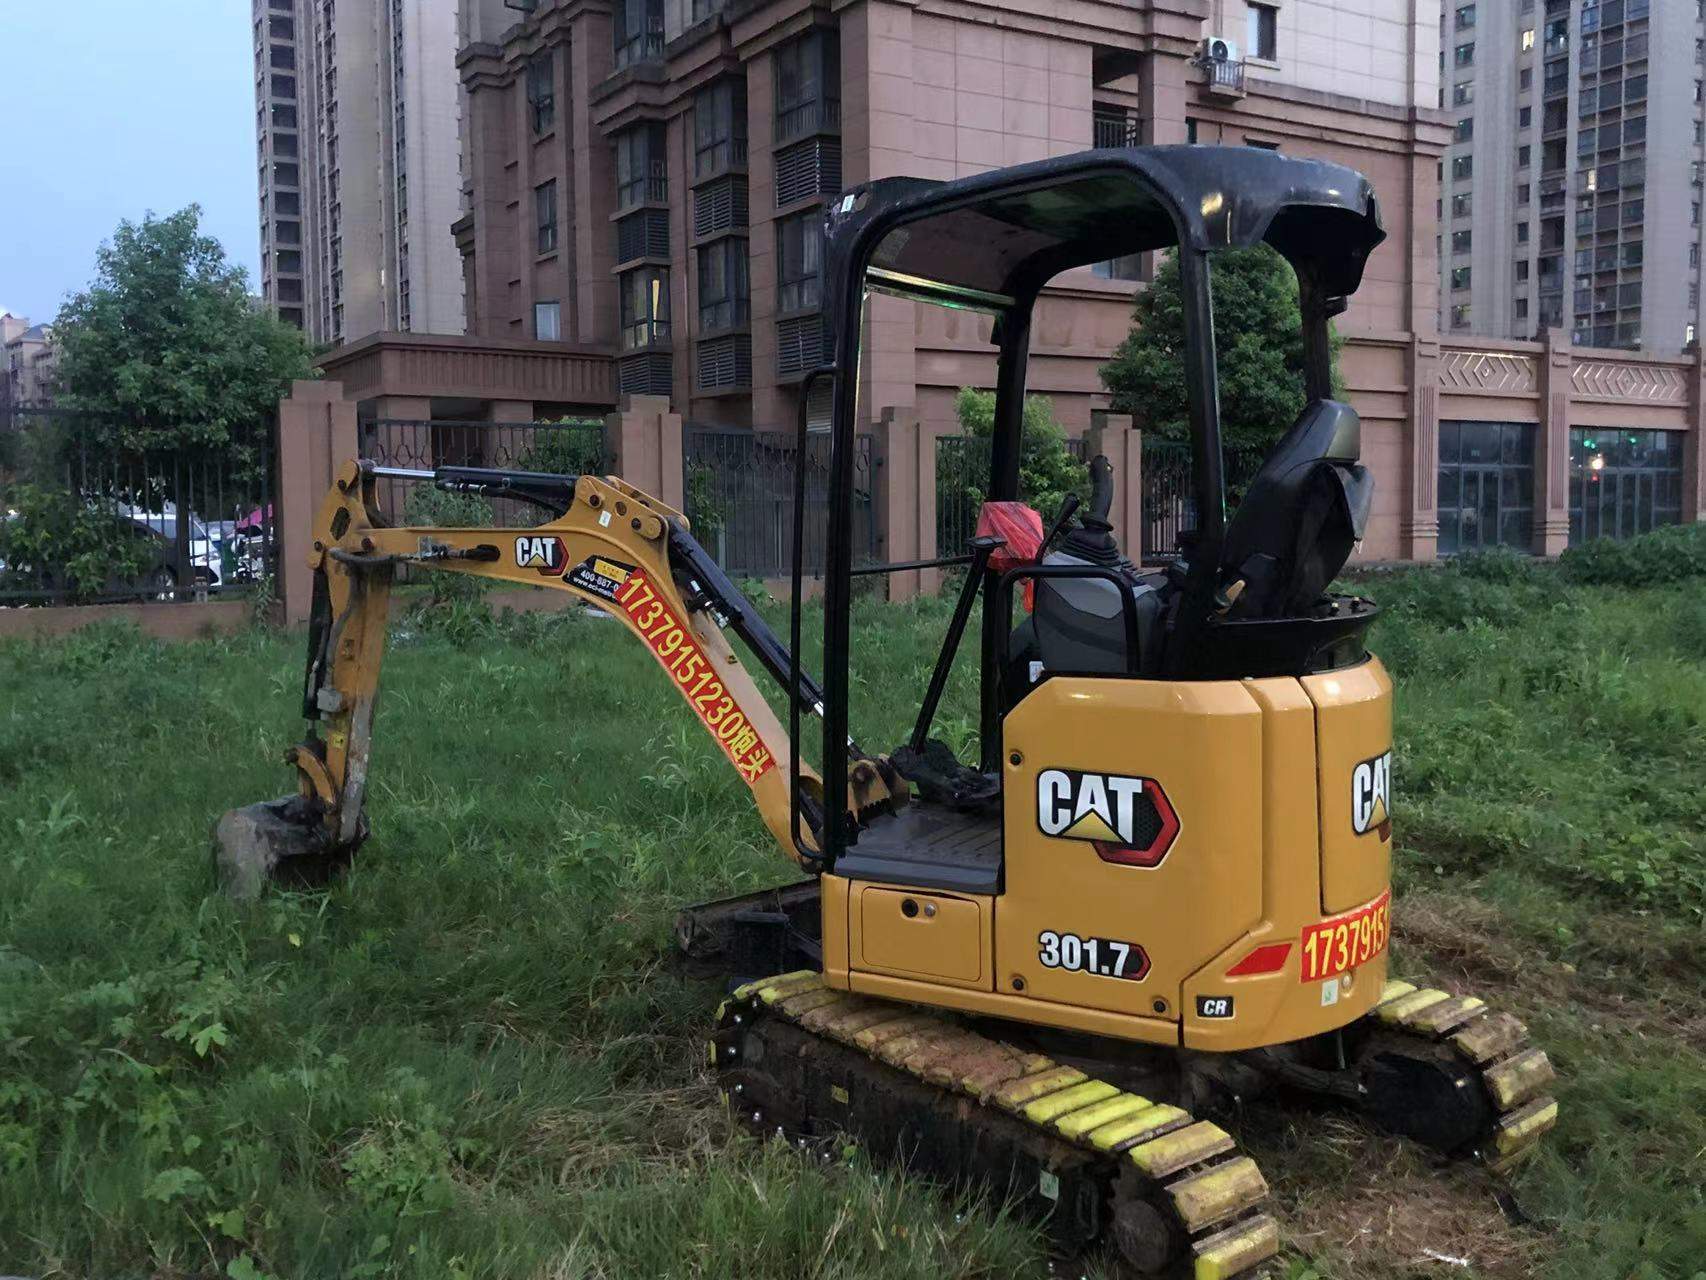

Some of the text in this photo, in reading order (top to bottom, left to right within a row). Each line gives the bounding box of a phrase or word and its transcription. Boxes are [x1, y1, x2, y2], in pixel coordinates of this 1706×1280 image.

[516, 537, 555, 567] CAT
[1039, 770, 1142, 844] CAT
[1040, 931, 1130, 977] 301.7
[1203, 1000, 1227, 1015] CR
